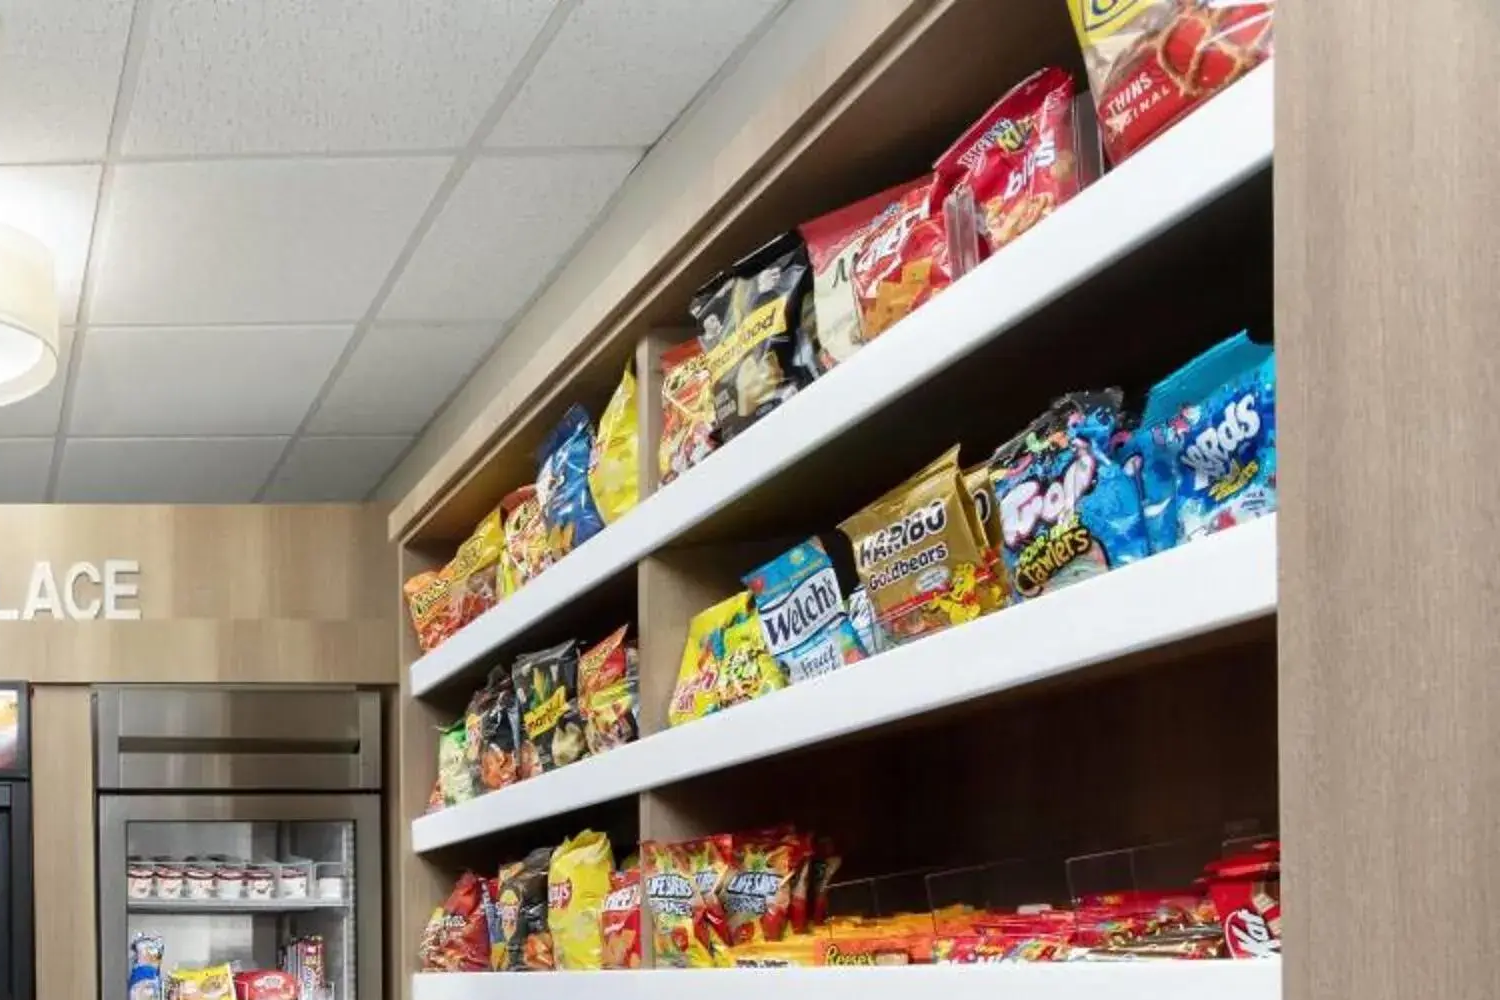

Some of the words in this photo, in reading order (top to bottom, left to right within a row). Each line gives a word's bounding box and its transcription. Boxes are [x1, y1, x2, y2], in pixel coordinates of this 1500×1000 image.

[868, 544, 947, 591] Goldbears
[1015, 527, 1090, 597] Crawlers
[764, 576, 837, 646] Welch's
